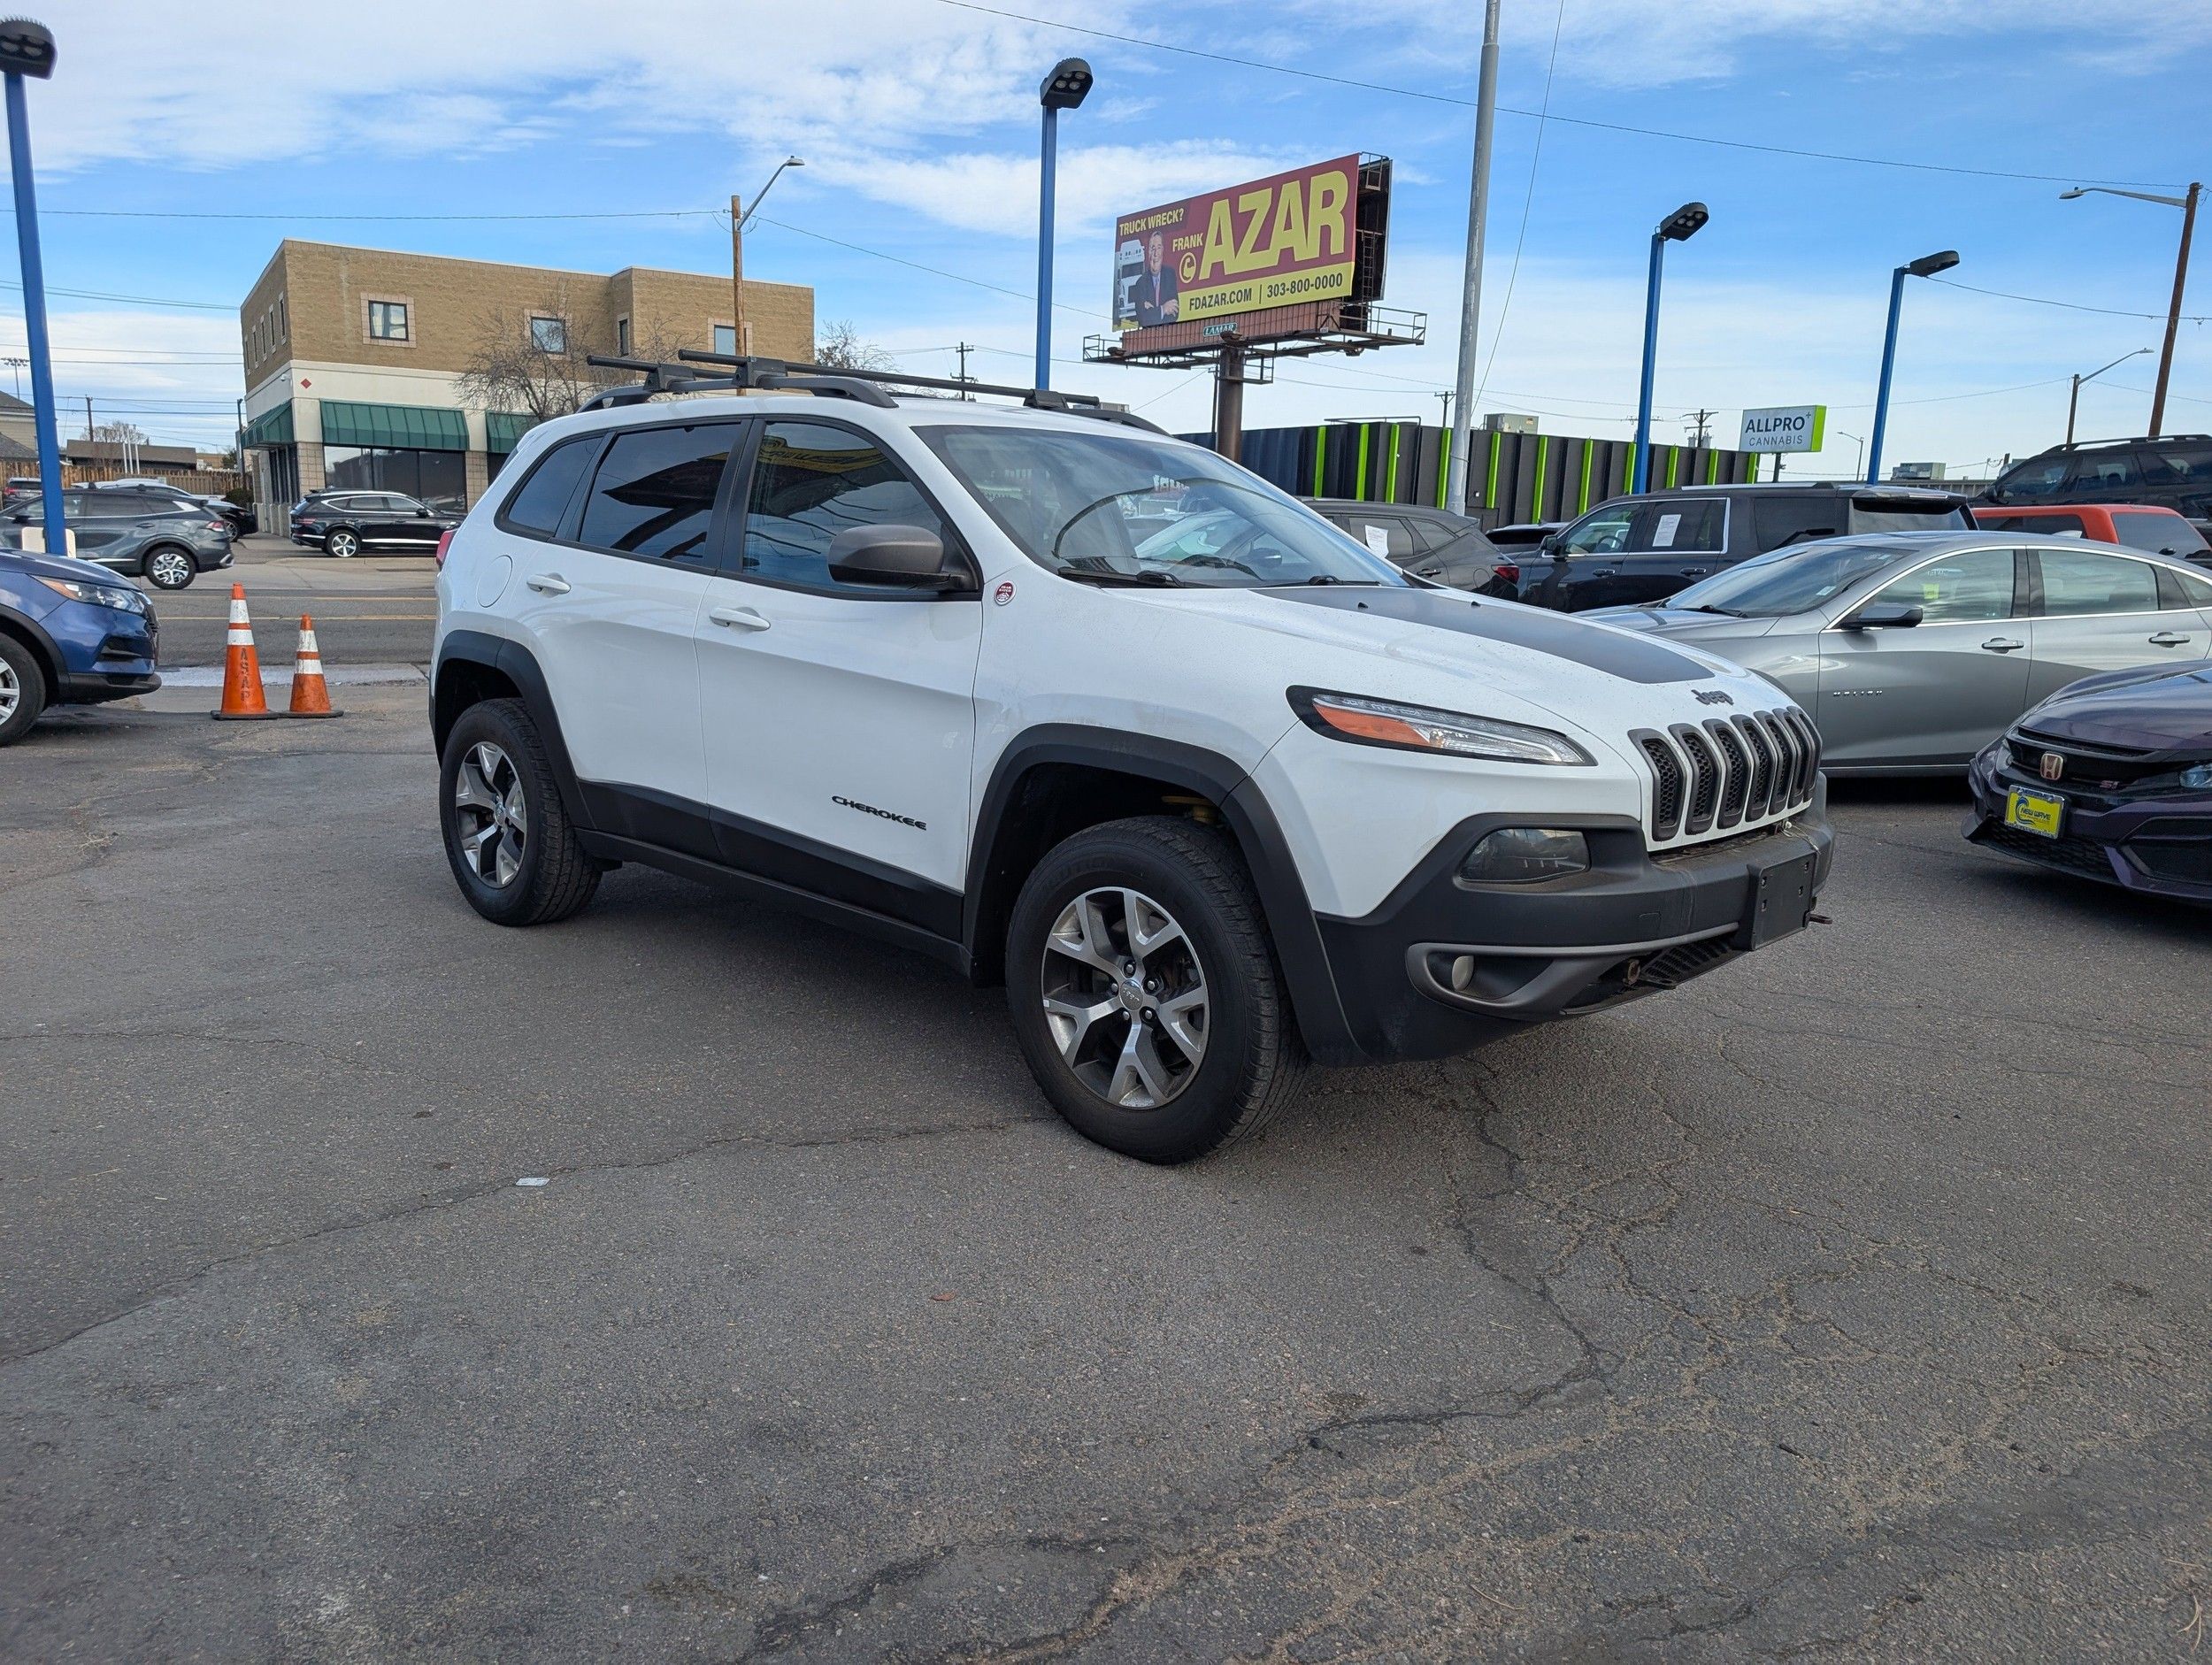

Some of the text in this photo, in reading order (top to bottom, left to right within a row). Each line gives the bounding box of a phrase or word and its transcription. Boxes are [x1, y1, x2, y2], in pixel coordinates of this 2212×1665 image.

[1119, 208, 1184, 236] TRUCK WRECK?
[1199, 170, 1348, 280] AZAR
[1172, 233, 1203, 252] FRANK
[1189, 272, 1343, 311] FDAZAR.COM 303-800-0000
[1205, 323, 1235, 335] LAMAR
[1748, 434, 1803, 446] CANNABIS
[1691, 689, 1734, 705] Jeep
[832, 795, 927, 831] CHEROKEE
